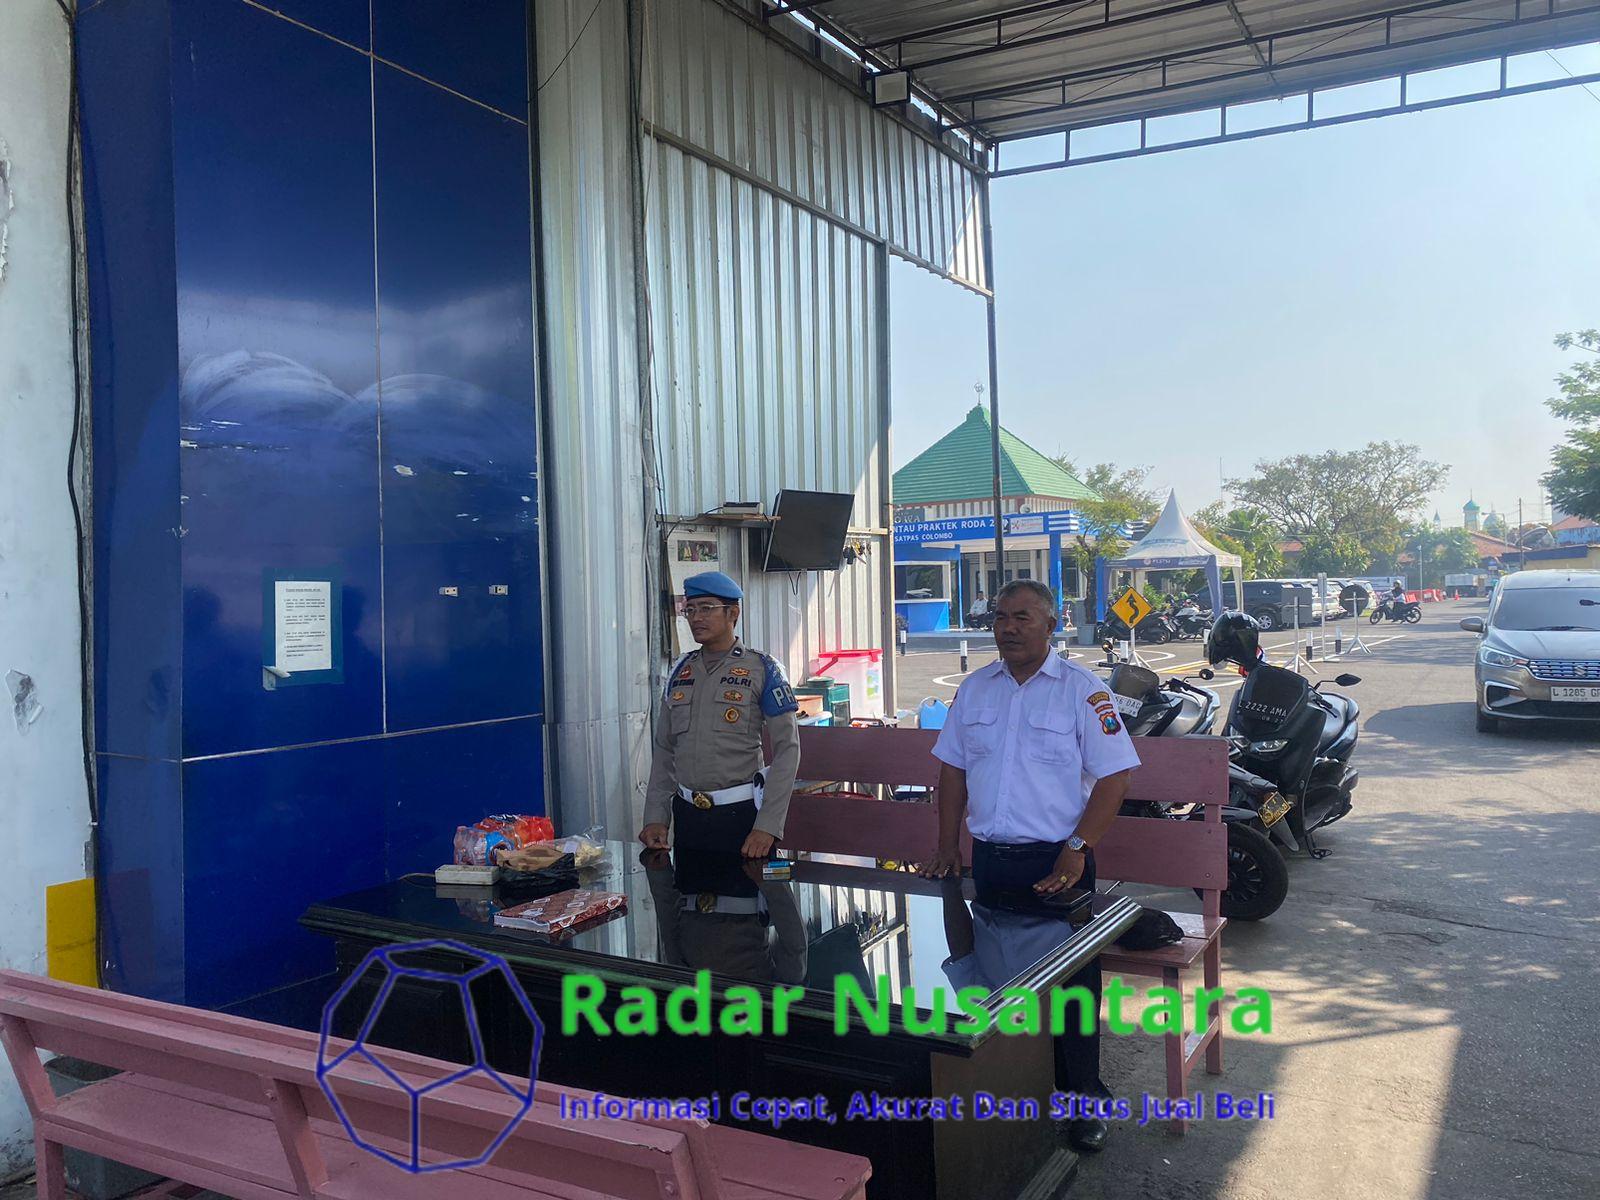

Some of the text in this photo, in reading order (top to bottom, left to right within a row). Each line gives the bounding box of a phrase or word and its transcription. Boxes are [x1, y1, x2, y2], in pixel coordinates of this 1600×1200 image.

[917, 521, 958, 532] PRAKTEK
[961, 519, 986, 529] RODA
[894, 532, 953, 542] SATPAS COLOMBO
[719, 676, 752, 687] POLRI
[1552, 688, 1559, 697] L
[1563, 688, 1586, 697] 1285
[1245, 701, 1268, 713] 2222
[1269, 707, 1287, 717] AMA
